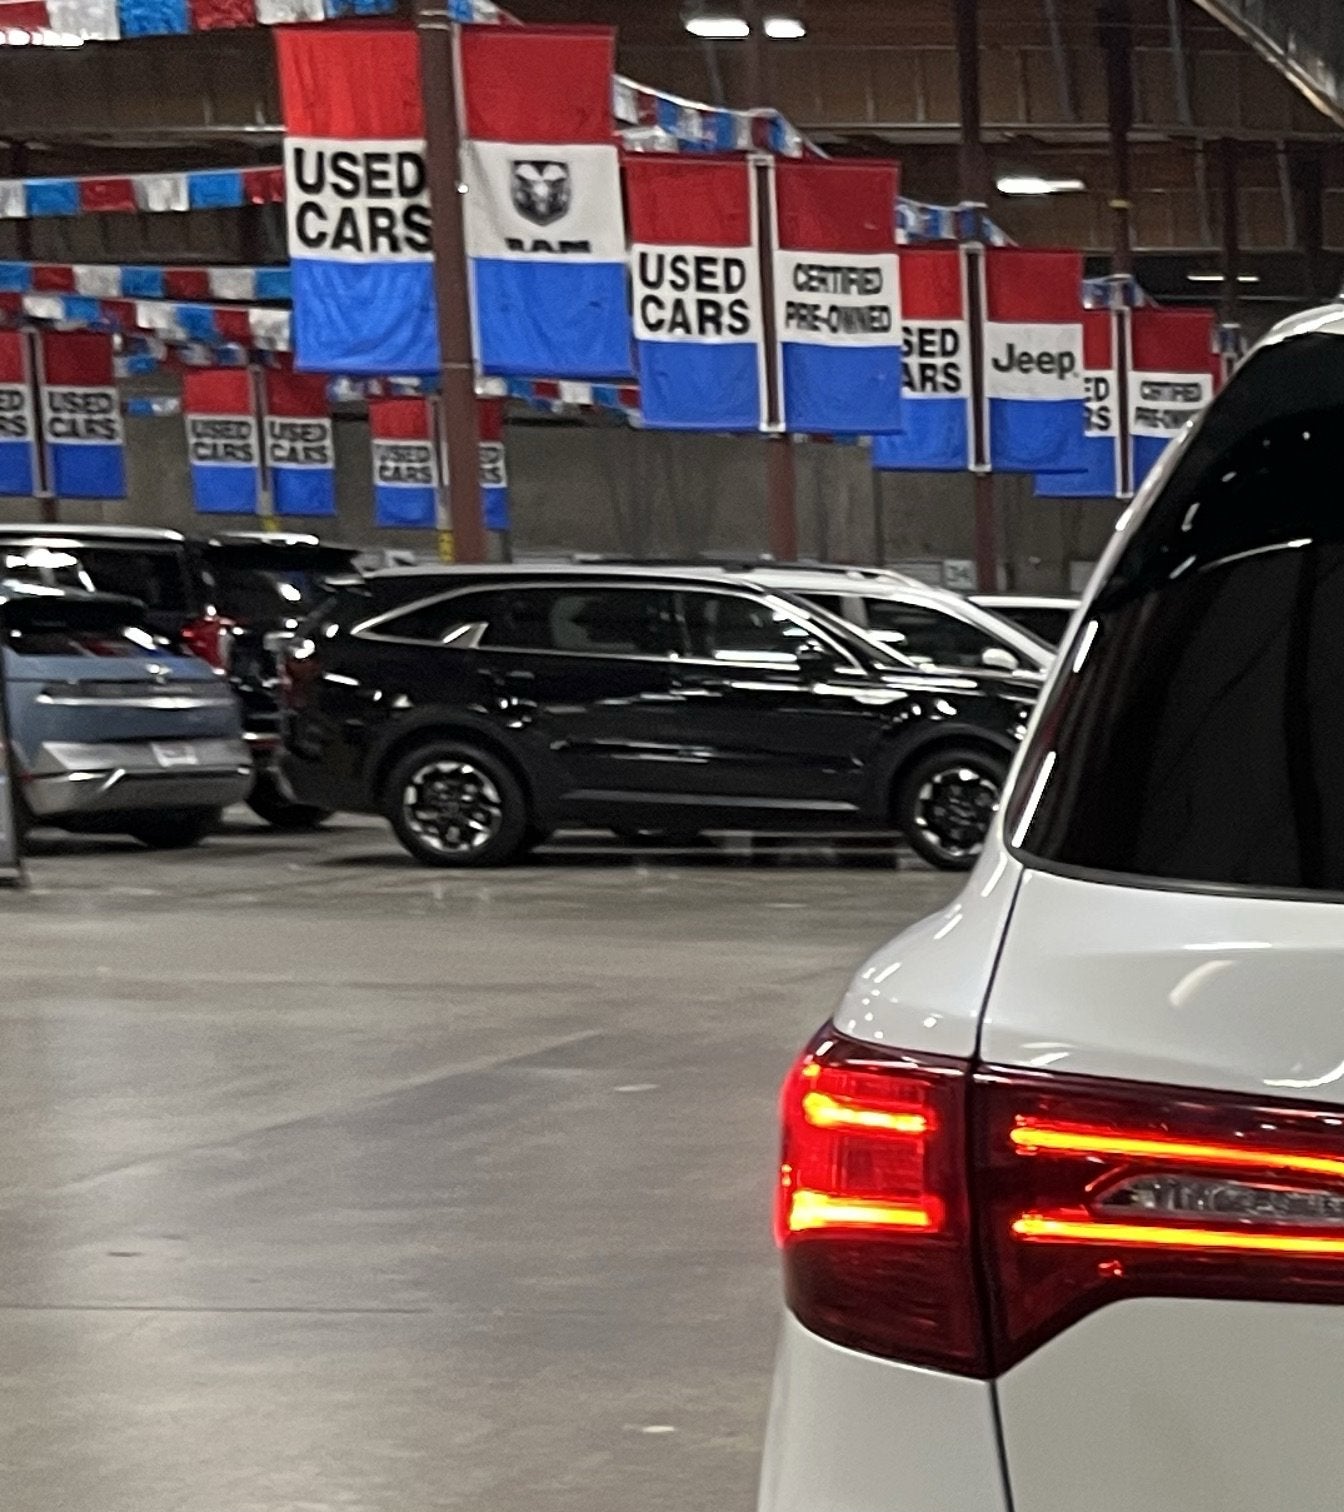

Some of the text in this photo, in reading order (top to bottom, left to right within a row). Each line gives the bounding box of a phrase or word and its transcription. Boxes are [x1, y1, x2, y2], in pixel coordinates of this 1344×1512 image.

[293, 147, 427, 200] USED
[295, 201, 435, 252] CARS
[504, 237, 592, 254] RAM
[639, 251, 746, 294] USED
[793, 262, 884, 296] CERTIFIED
[640, 294, 751, 336] CARS
[785, 301, 892, 334] PRE-OWNED
[901, 326, 960, 358] SED
[991, 342, 1076, 380] Jeep
[901, 362, 962, 393] ARS
[48, 391, 113, 414] USED
[49, 417, 117, 440] CARS
[191, 420, 252, 440] USED
[270, 421, 328, 442] USED
[193, 441, 253, 462] CARS
[270, 443, 328, 463] CARS
